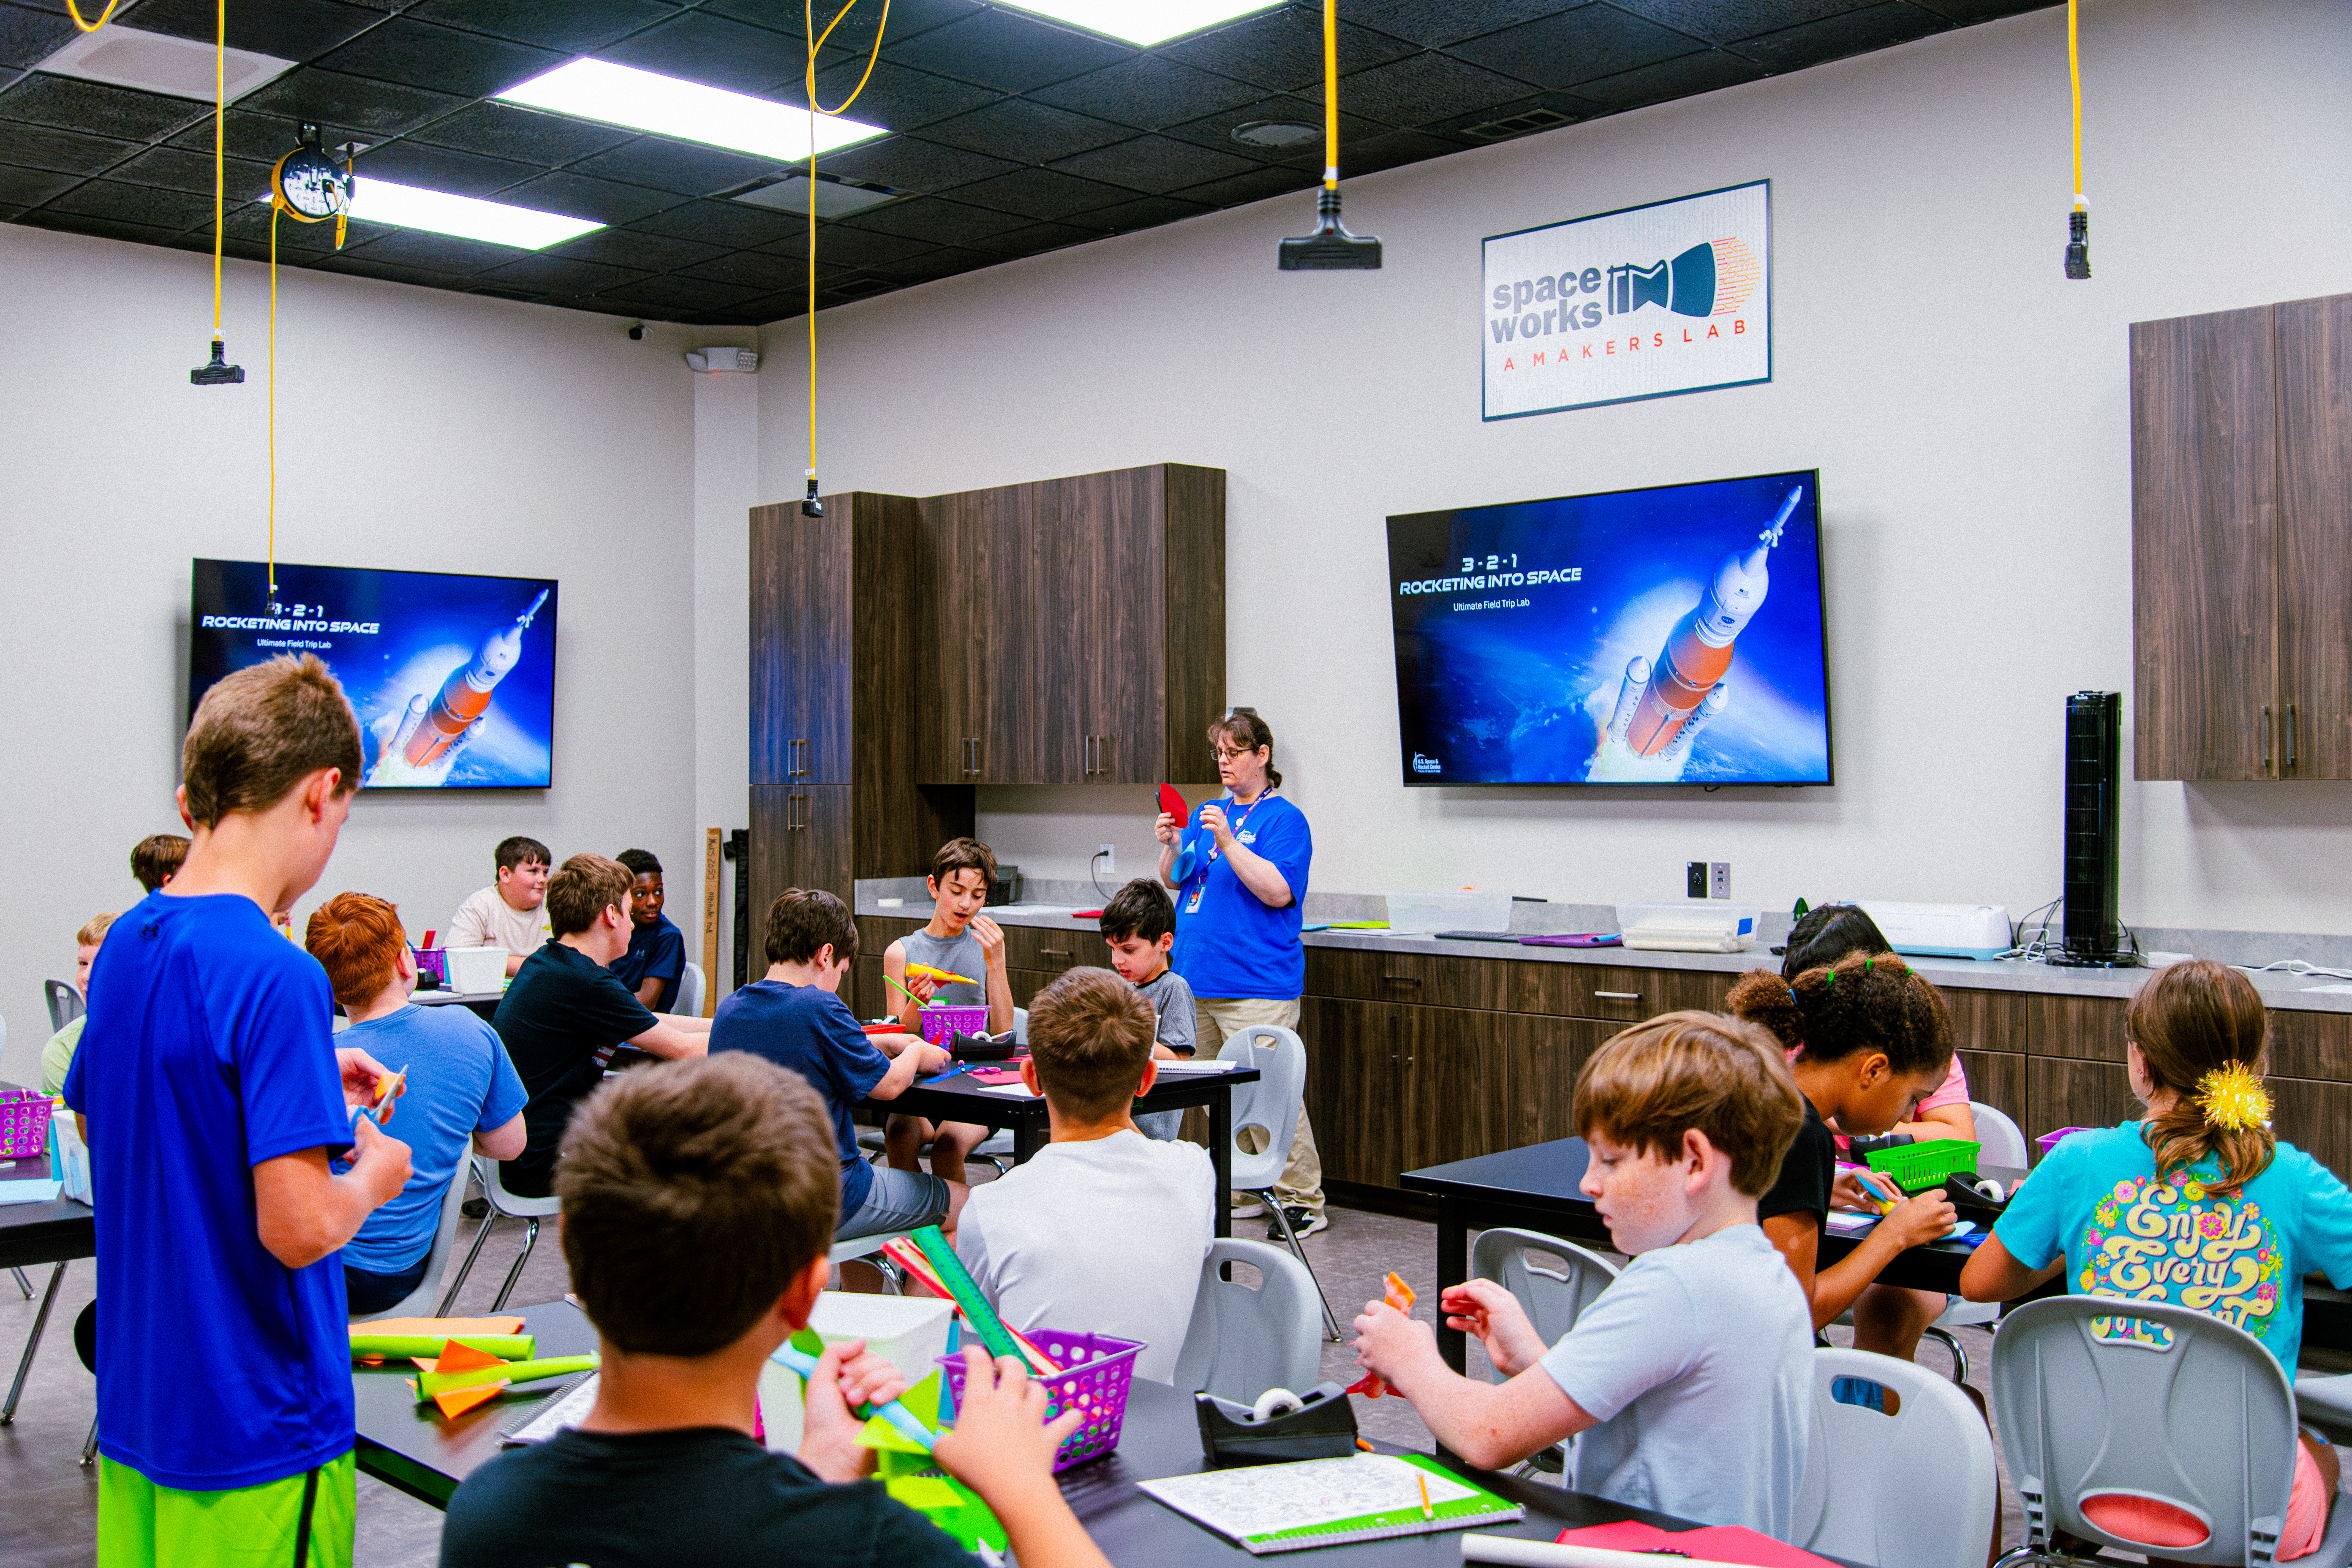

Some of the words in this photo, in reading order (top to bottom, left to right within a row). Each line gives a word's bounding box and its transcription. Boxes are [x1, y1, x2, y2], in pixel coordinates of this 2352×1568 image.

[1493, 267, 1601, 314] space
[1490, 299, 1602, 343] works
[1504, 357, 1514, 371] A
[1399, 576, 1485, 595] ROCKETING
[1488, 573, 1524, 588] INTO
[1527, 567, 1582, 585] SPACE
[1453, 602, 1482, 611] Ultimate
[1484, 600, 1500, 609] Field
[1501, 599, 1515, 609] Trip
[1516, 598, 1530, 607] Lab
[201, 615, 291, 630] ROCKETING
[292, 619, 328, 632] INTO
[329, 621, 380, 634] SPACE
[257, 638, 286, 647] Ultimate
[287, 640, 303, 648] Field
[304, 640, 318, 649] Trip
[2102, 1235, 2260, 1309] Every
